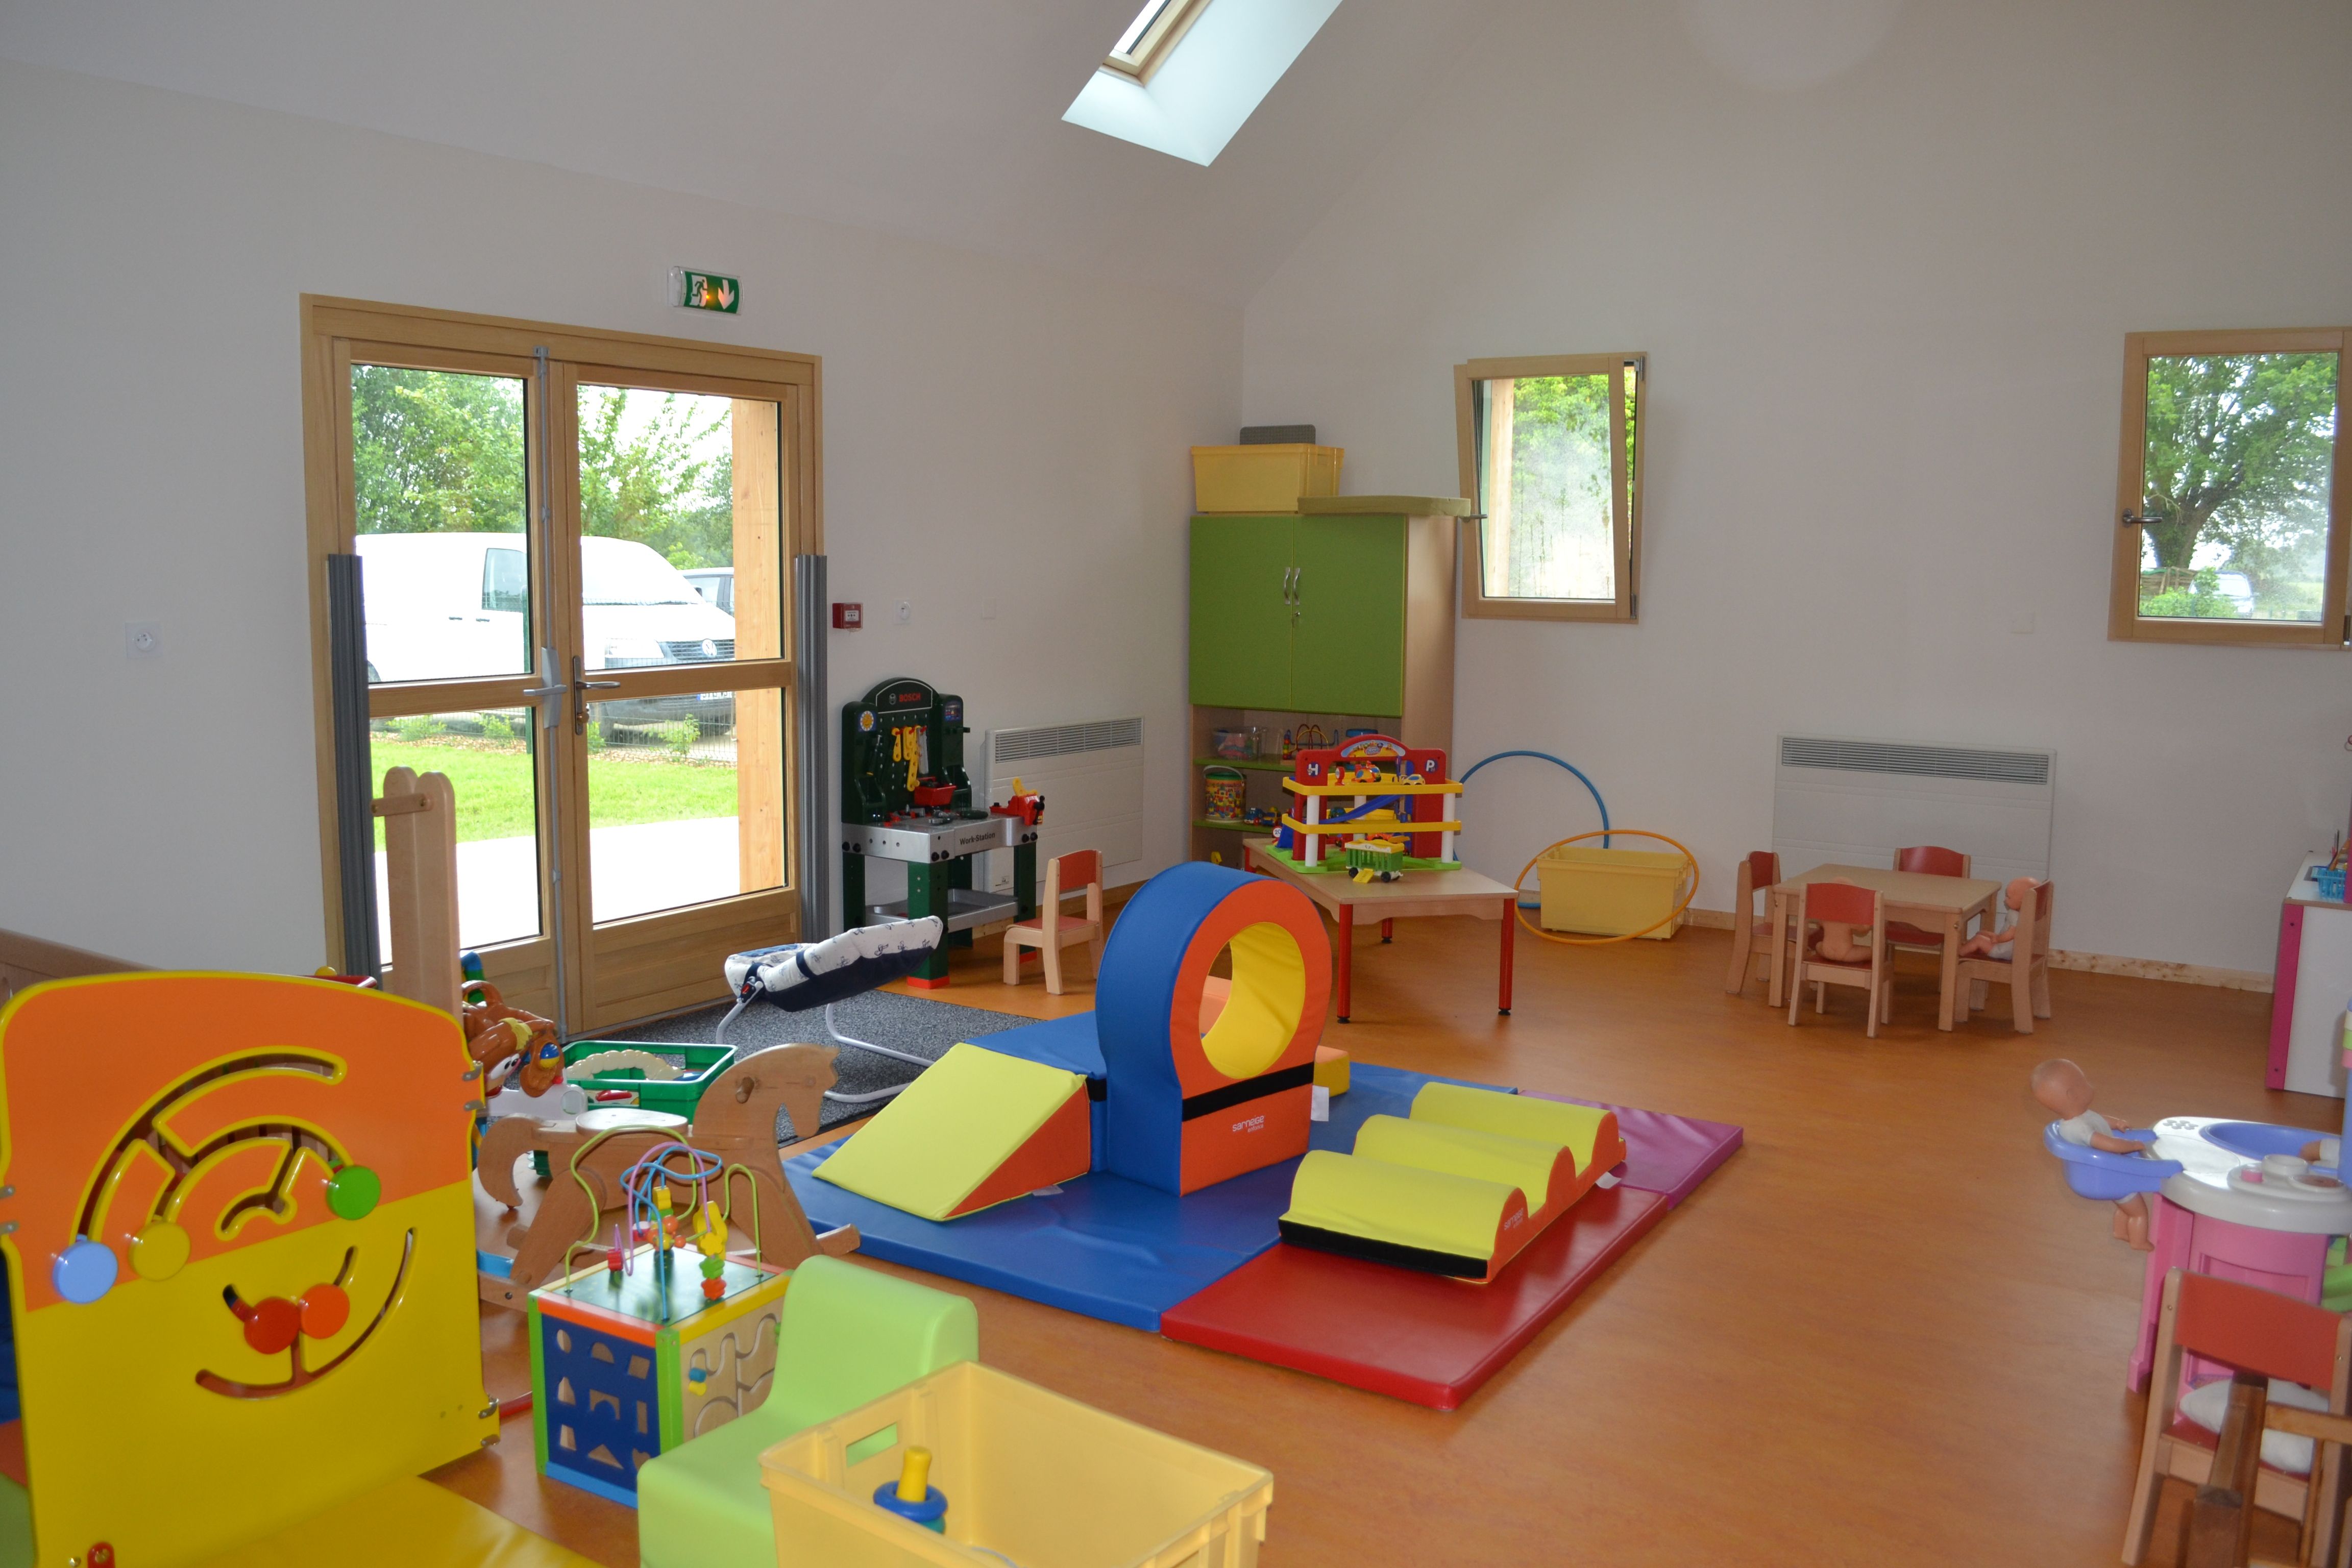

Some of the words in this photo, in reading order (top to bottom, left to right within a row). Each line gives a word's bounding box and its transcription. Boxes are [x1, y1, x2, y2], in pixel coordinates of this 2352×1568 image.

[899, 693, 921, 702] BOSCH
[1308, 764, 1318, 775] H
[1426, 760, 1435, 772] P
[960, 832, 995, 845] Work-Station
